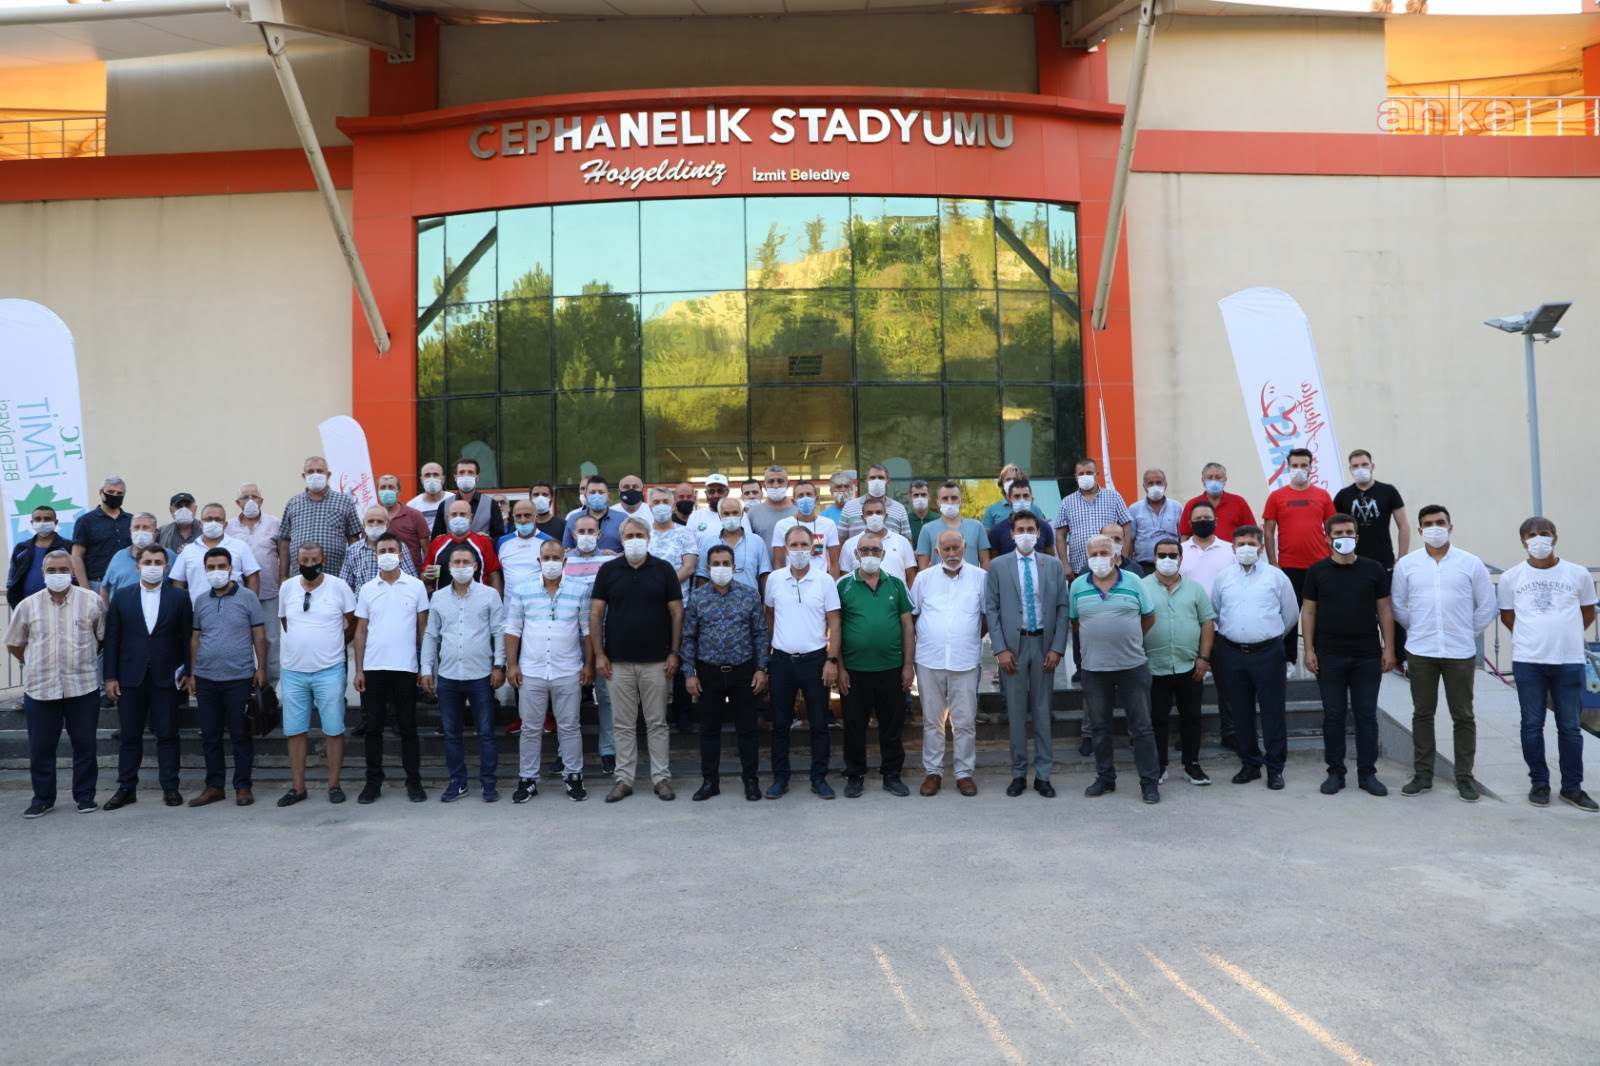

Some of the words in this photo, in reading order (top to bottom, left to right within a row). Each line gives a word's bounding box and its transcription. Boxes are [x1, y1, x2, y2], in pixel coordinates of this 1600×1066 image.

[469, 104, 752, 159] CEPHANELİK
[769, 108, 1014, 149] STADYUMU
[580, 158, 727, 190] Hoşgeldiniz
[752, 167, 787, 182] İzmit
[790, 168, 851, 183] Belediye
[1516, 580, 1548, 595] SAILING
